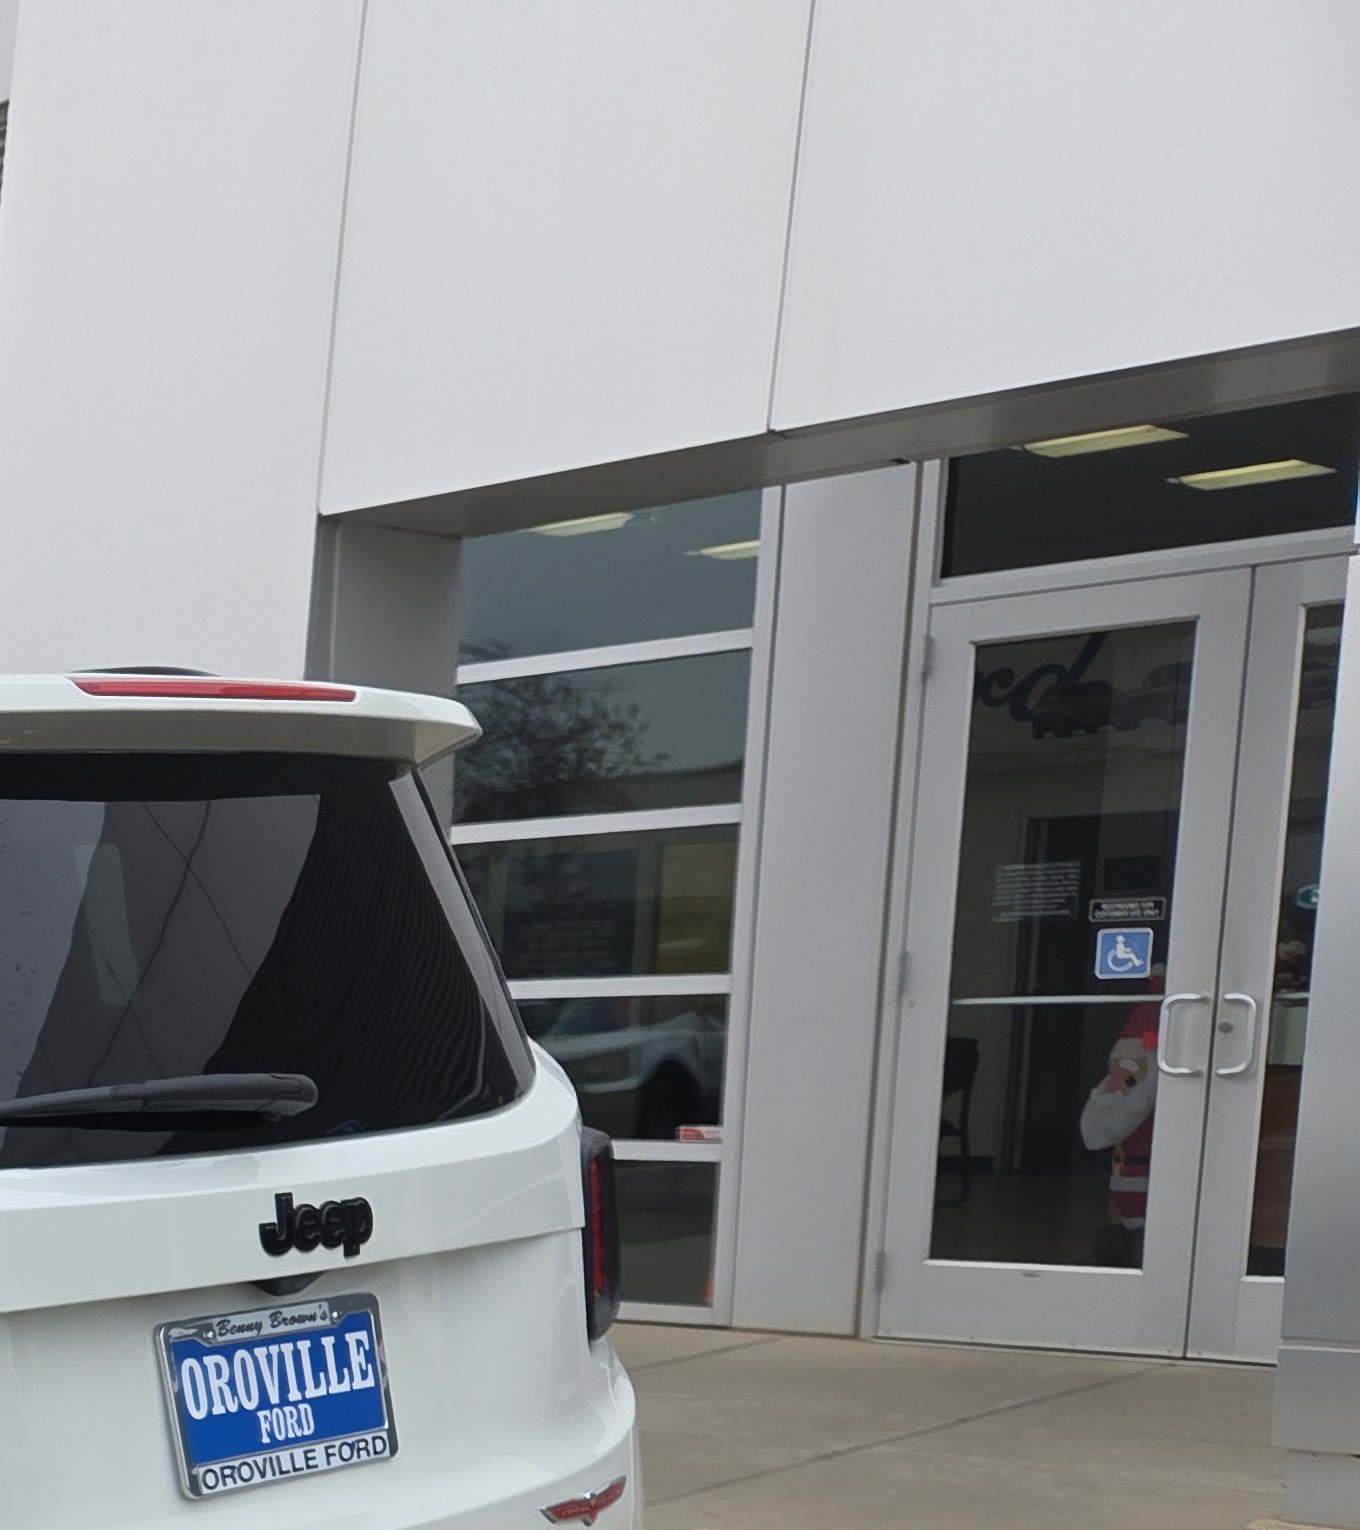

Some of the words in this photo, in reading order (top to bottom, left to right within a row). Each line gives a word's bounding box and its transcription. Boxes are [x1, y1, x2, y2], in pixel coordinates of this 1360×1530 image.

[259, 1192, 373, 1258] Jeep
[216, 1318, 263, 1336] Benny
[269, 1303, 328, 1330] Brown's
[181, 1330, 375, 1420] OROVILLE
[257, 1403, 315, 1444] FORD
[202, 1448, 319, 1490] OROVILLE
[325, 1436, 387, 1467] FORD
